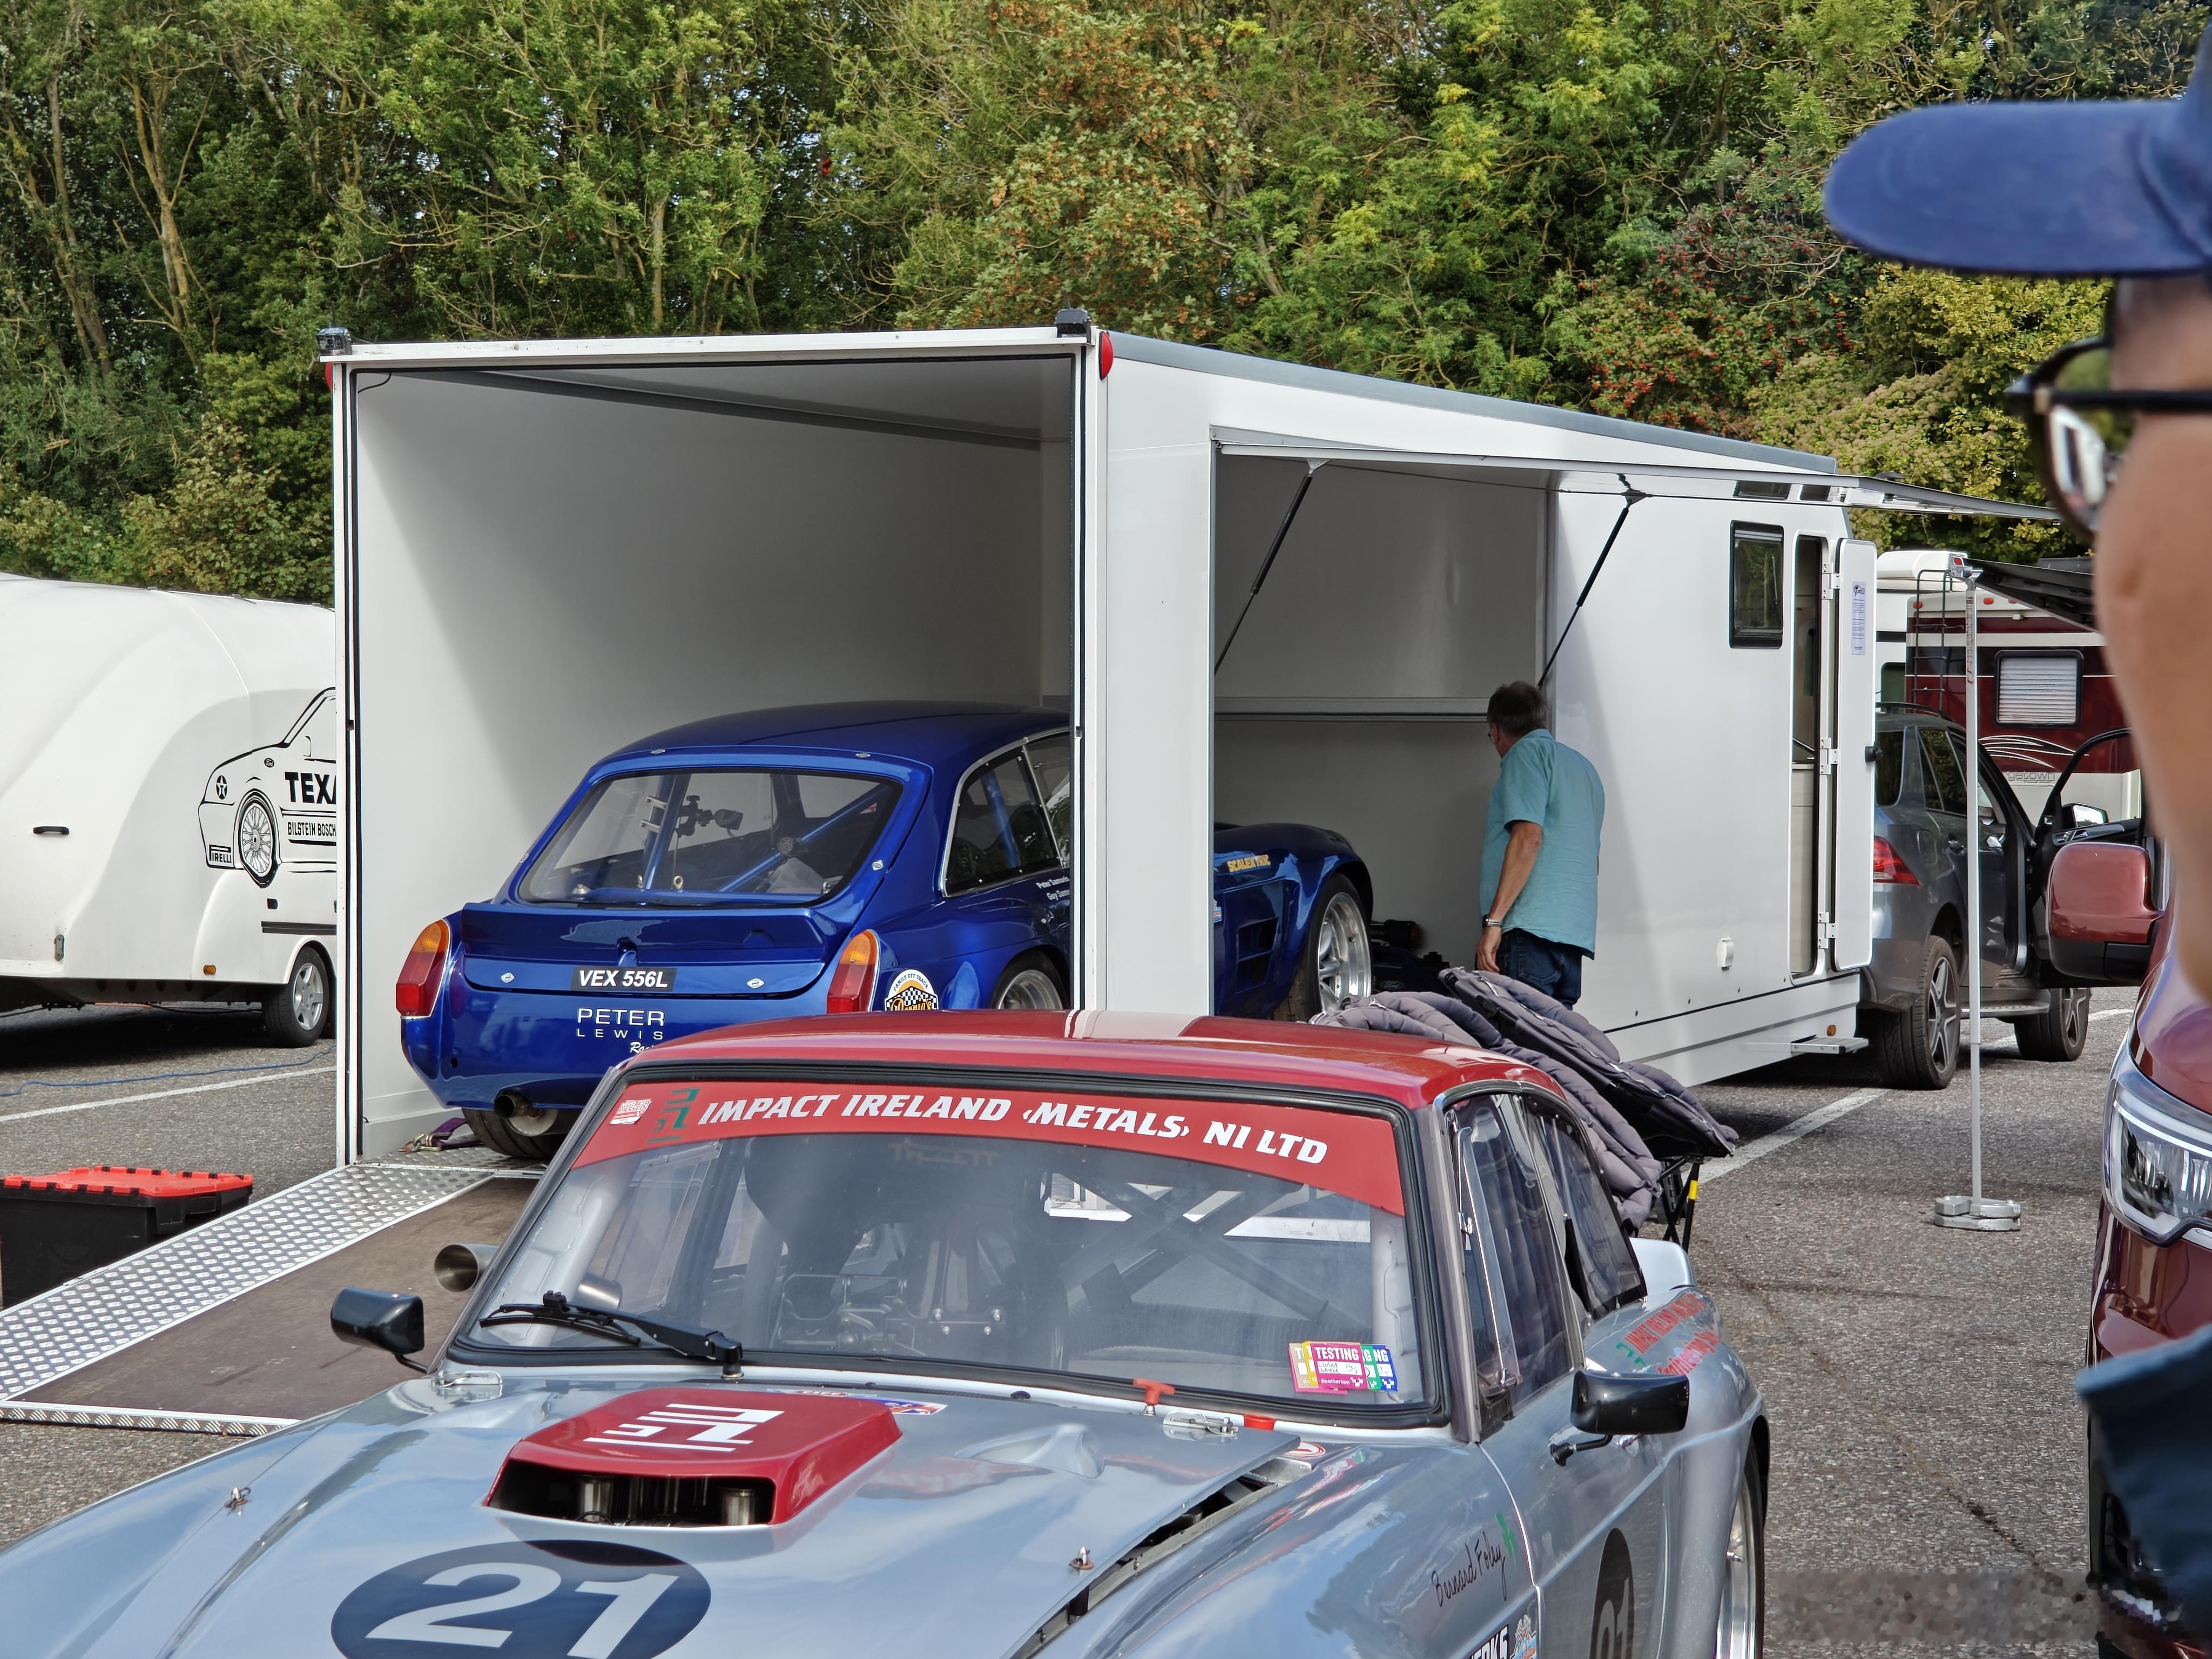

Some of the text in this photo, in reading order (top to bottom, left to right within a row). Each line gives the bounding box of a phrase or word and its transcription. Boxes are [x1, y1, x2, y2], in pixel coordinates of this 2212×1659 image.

[287, 822, 316, 836] BILSTEIN
[209, 844, 232, 864] PIRELLI
[579, 970, 668, 988] VEX 556L
[894, 974, 907, 992] FAMILY
[916, 975, 929, 989] TRACK
[577, 1008, 664, 1026] PETER
[577, 1028, 663, 1040] LEWIS
[698, 1094, 840, 1125] IMPACT
[840, 1095, 1011, 1122] IRELAND
[1203, 1121, 1254, 1149] NI
[1256, 1129, 1327, 1164] LTD
[1314, 1347, 1359, 1361] TESTING
[365, 1562, 680, 1659] 21
